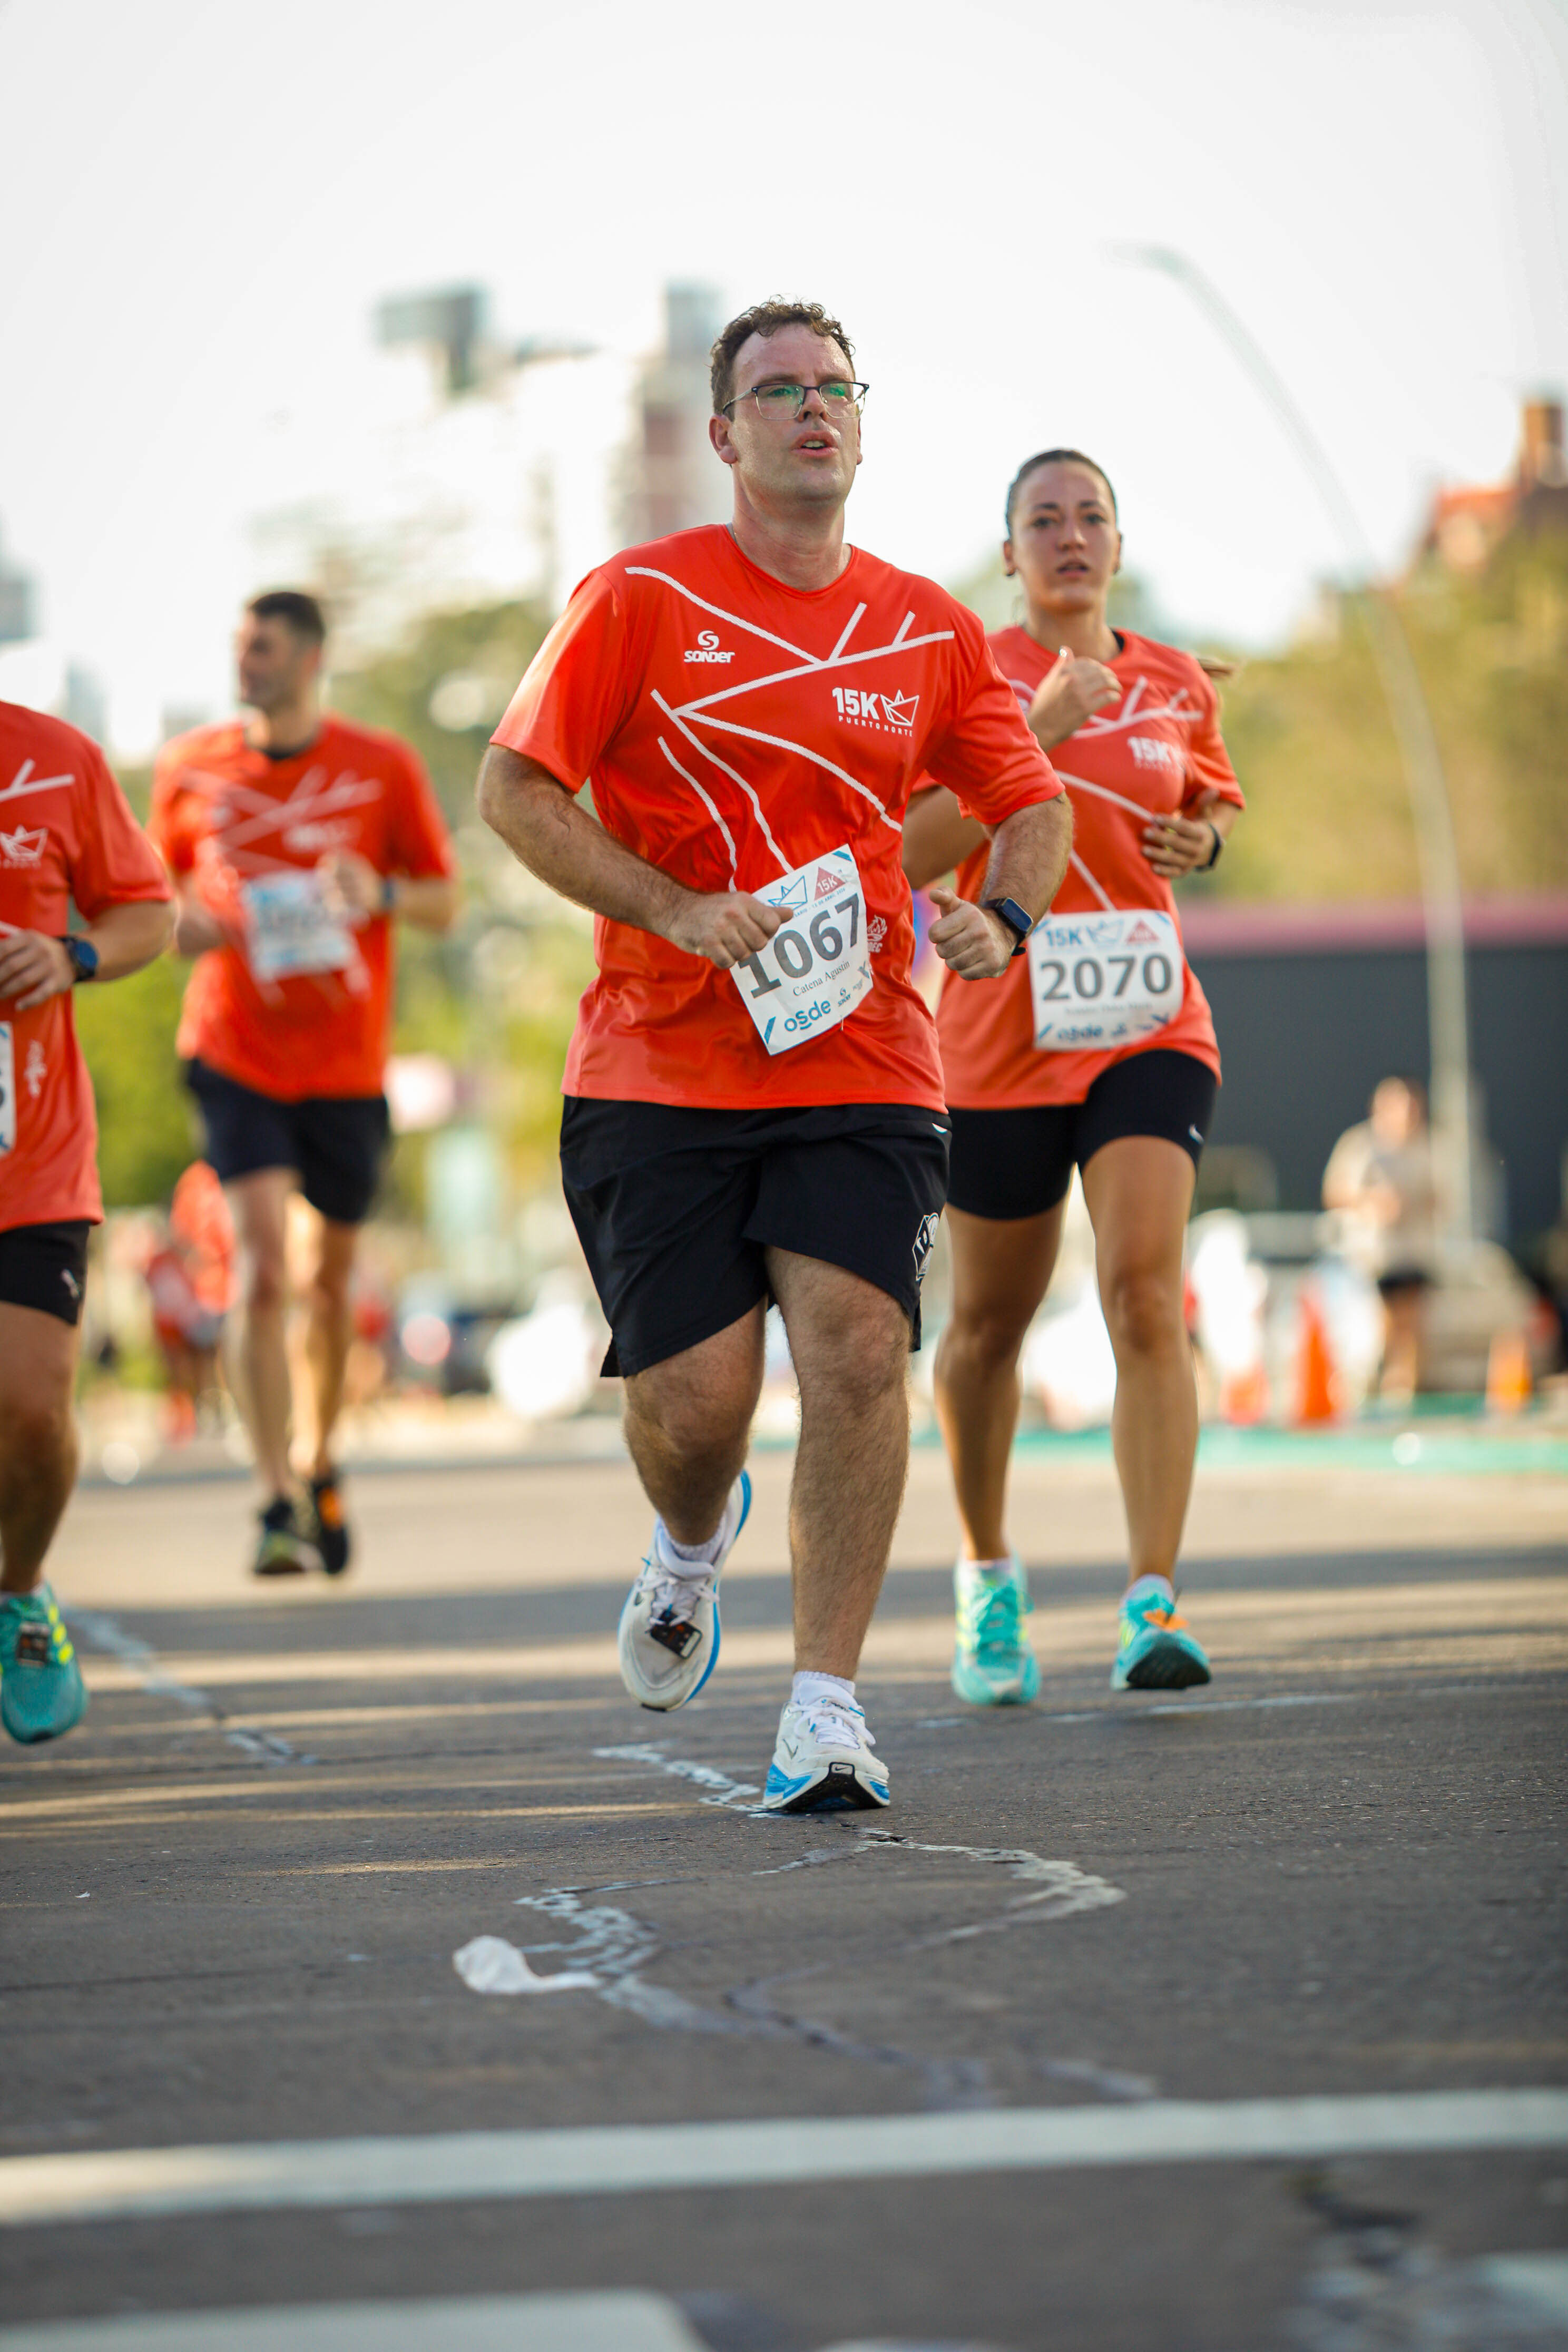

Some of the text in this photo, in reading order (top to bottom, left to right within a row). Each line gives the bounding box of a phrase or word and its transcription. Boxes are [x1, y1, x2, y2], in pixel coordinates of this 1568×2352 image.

[832, 687, 880, 720] 15K
[838, 716, 913, 737] PUERTO NORTE
[1127, 736, 1172, 763] 15K
[817, 875, 838, 893] 15K
[738, 893, 859, 999] 1067
[1045, 927, 1083, 947] 15K
[792, 976, 824, 997] Catena
[1040, 953, 1173, 1000] 2070
[784, 999, 831, 1032] osde
